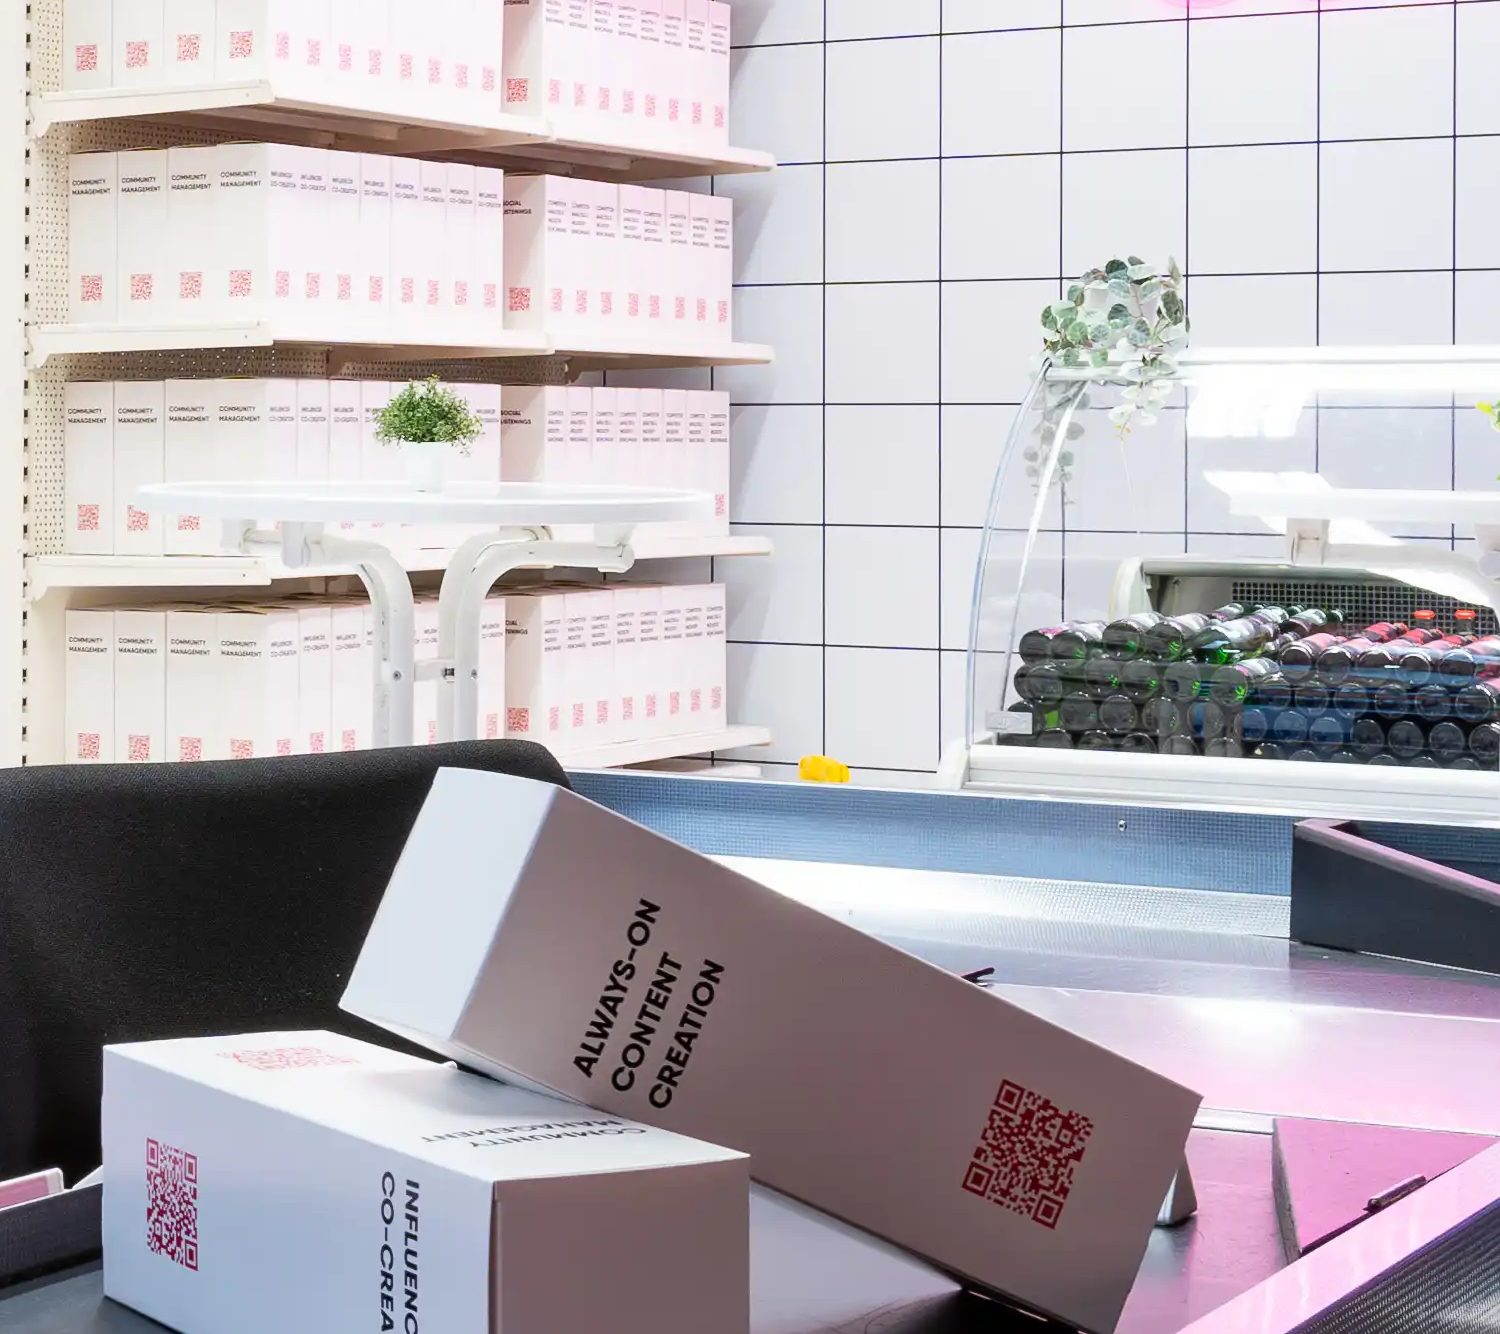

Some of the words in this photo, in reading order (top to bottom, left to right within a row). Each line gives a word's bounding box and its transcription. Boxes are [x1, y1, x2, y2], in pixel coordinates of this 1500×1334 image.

[218, 405, 256, 413] COMMUNITY
[571, 897, 661, 1080] ALWAYS-ON
[611, 949, 685, 1095] CONTENT
[648, 959, 726, 1111] CREATION
[471, 1127, 647, 1149] COMMUNITY
